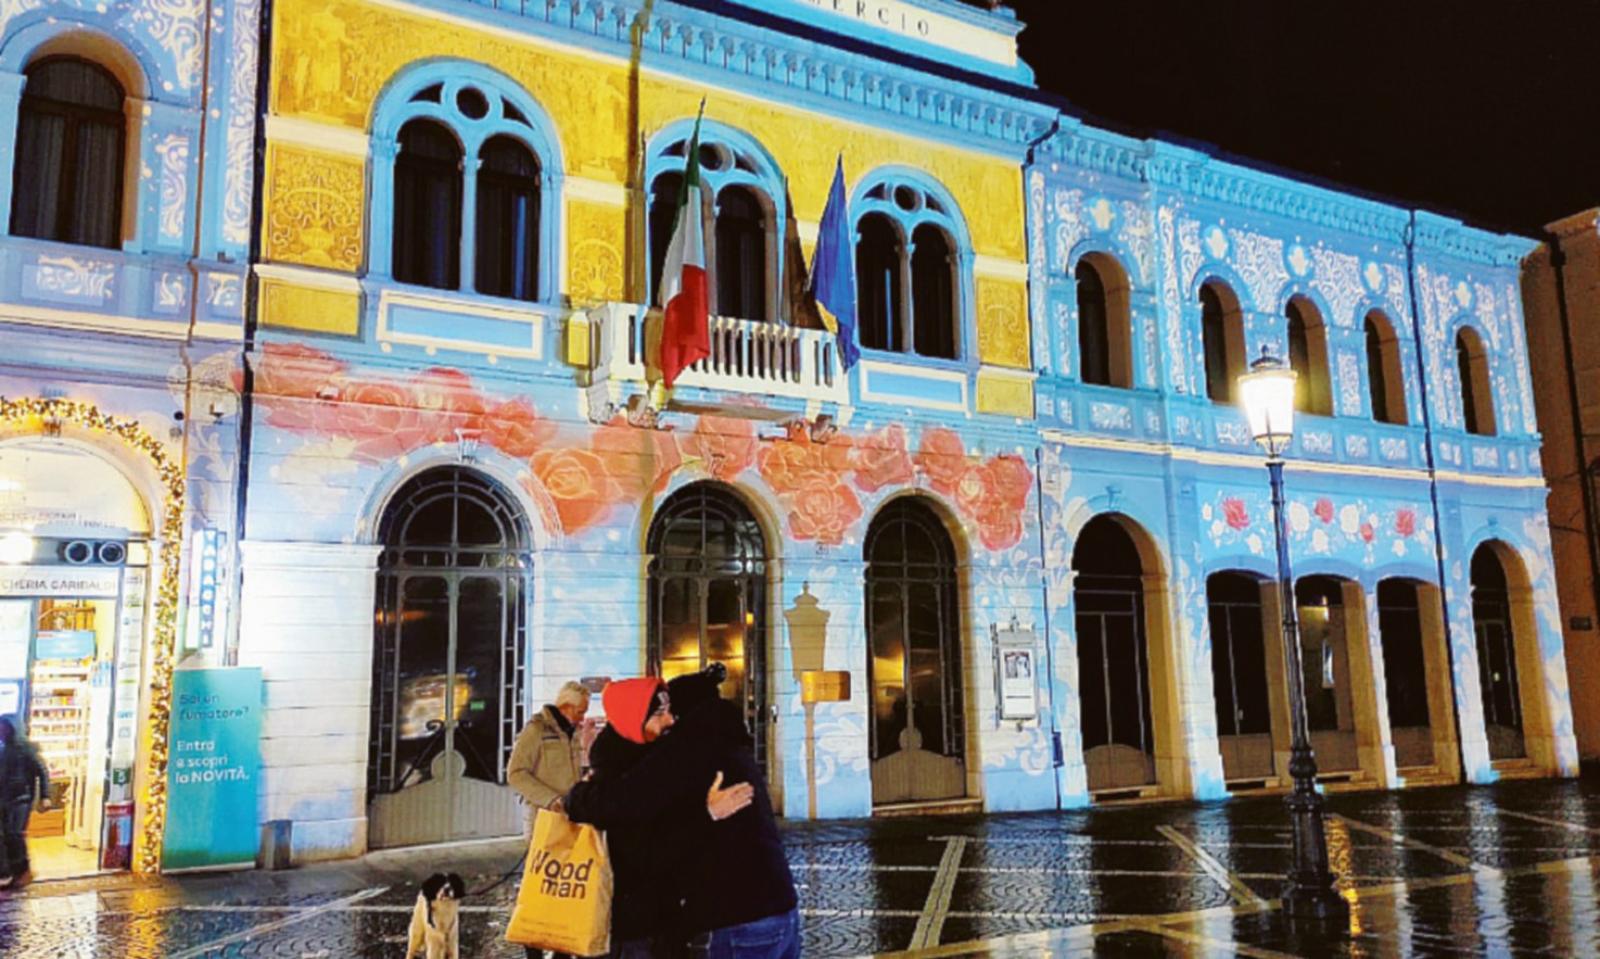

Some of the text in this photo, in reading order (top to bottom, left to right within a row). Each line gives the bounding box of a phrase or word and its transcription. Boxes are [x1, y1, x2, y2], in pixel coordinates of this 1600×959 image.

[188, 754, 228, 769] scopri
[530, 850, 593, 881] Wood
[540, 878, 586, 899] man
